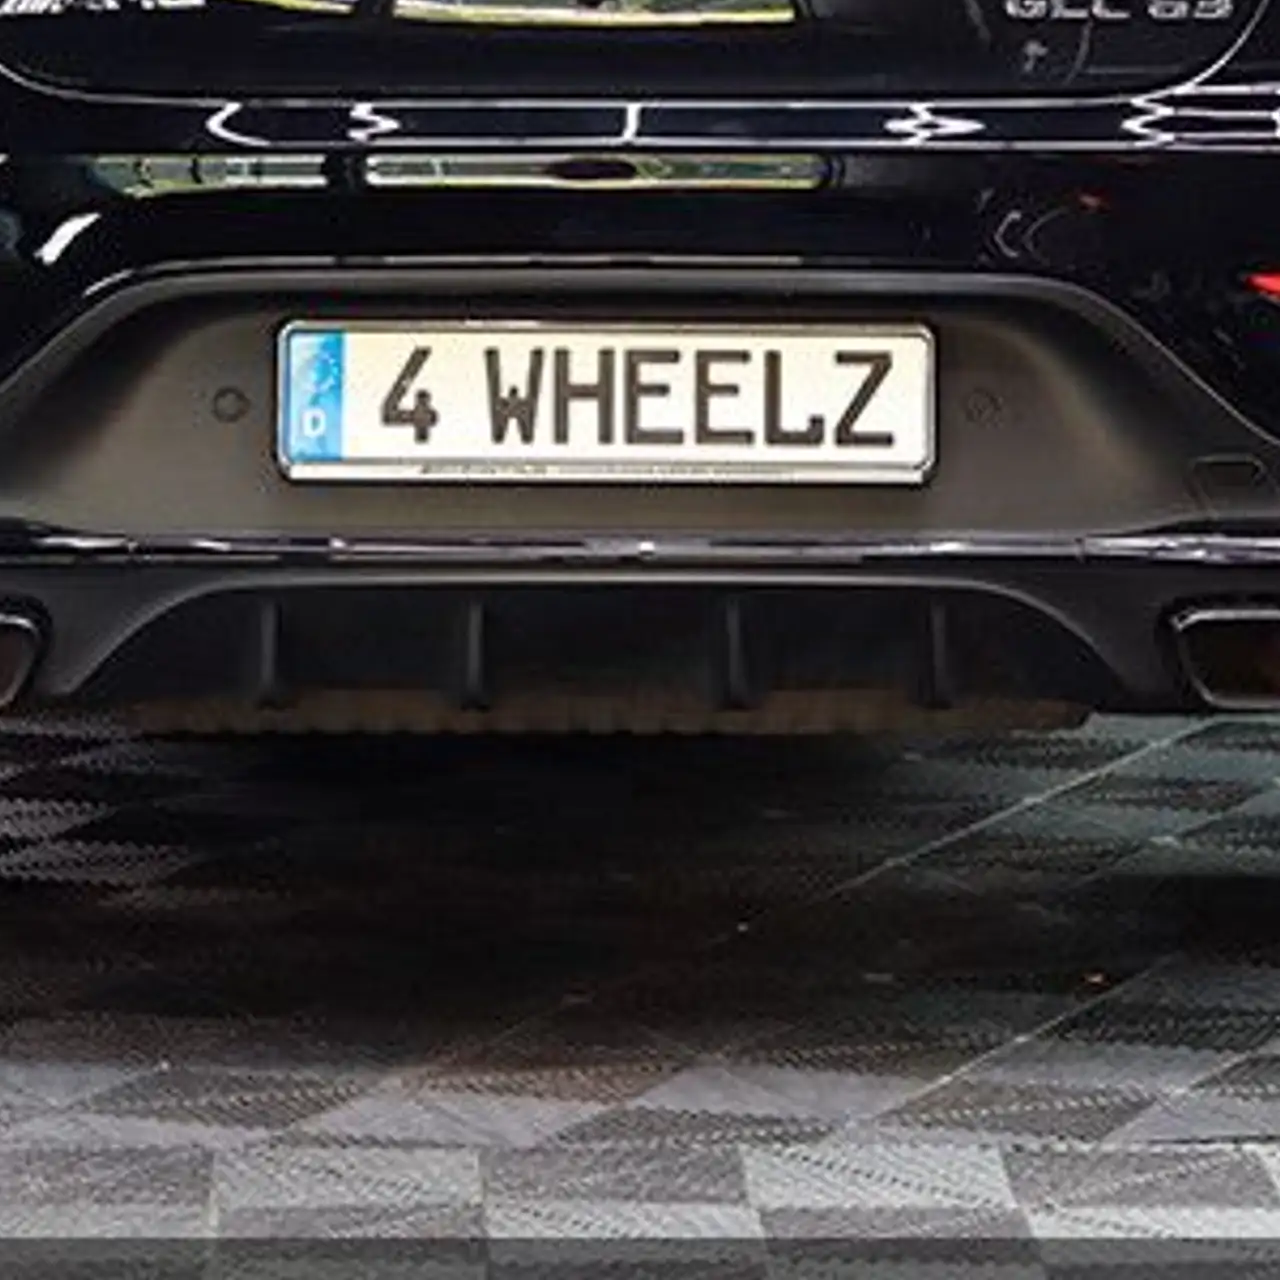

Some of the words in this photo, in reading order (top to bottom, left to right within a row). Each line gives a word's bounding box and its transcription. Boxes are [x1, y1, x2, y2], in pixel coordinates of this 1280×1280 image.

[301, 409, 327, 439] D
[380, 346, 439, 444] 4
[484, 346, 895, 448] WHEELZ
